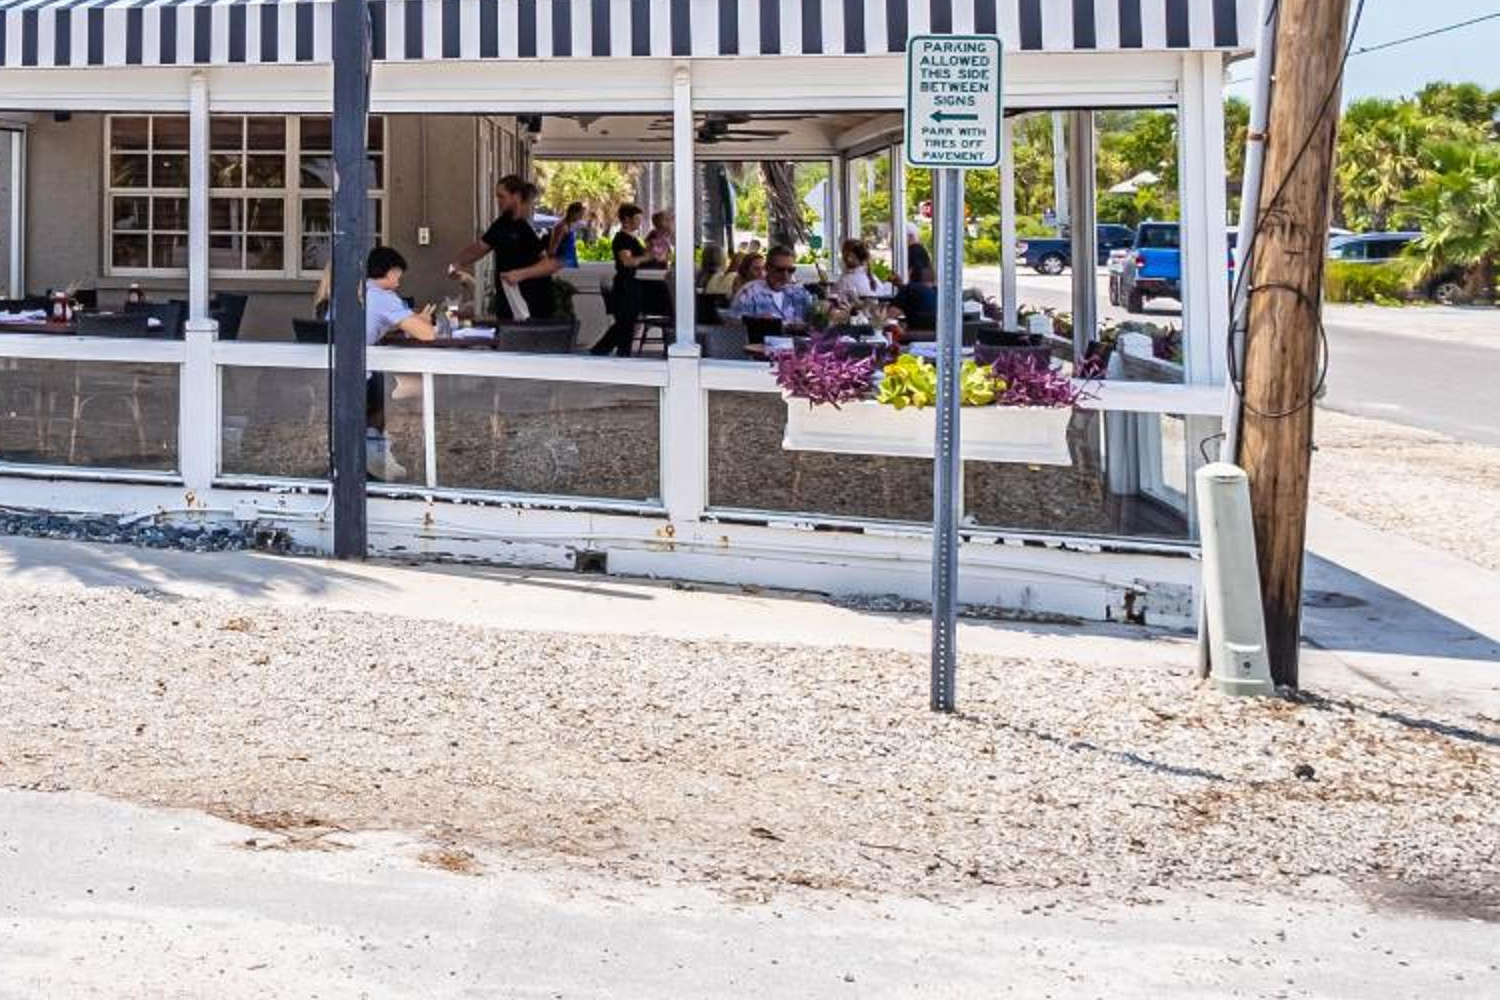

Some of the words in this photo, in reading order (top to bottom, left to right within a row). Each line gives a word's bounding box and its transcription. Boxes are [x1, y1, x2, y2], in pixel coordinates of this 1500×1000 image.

[923, 42, 986, 52] PARKING
[920, 56, 990, 66] ALLOWED
[920, 68, 951, 79] THIS
[957, 69, 989, 80] SIDE
[920, 82, 989, 92] BETWEEN
[934, 96, 975, 106] SIGNS
[921, 127, 953, 136] PARK
[958, 128, 986, 136] WITH
[924, 139, 956, 148] TIRES
[961, 139, 984, 148] OFF
[922, 152, 985, 160] PAVEMENT
